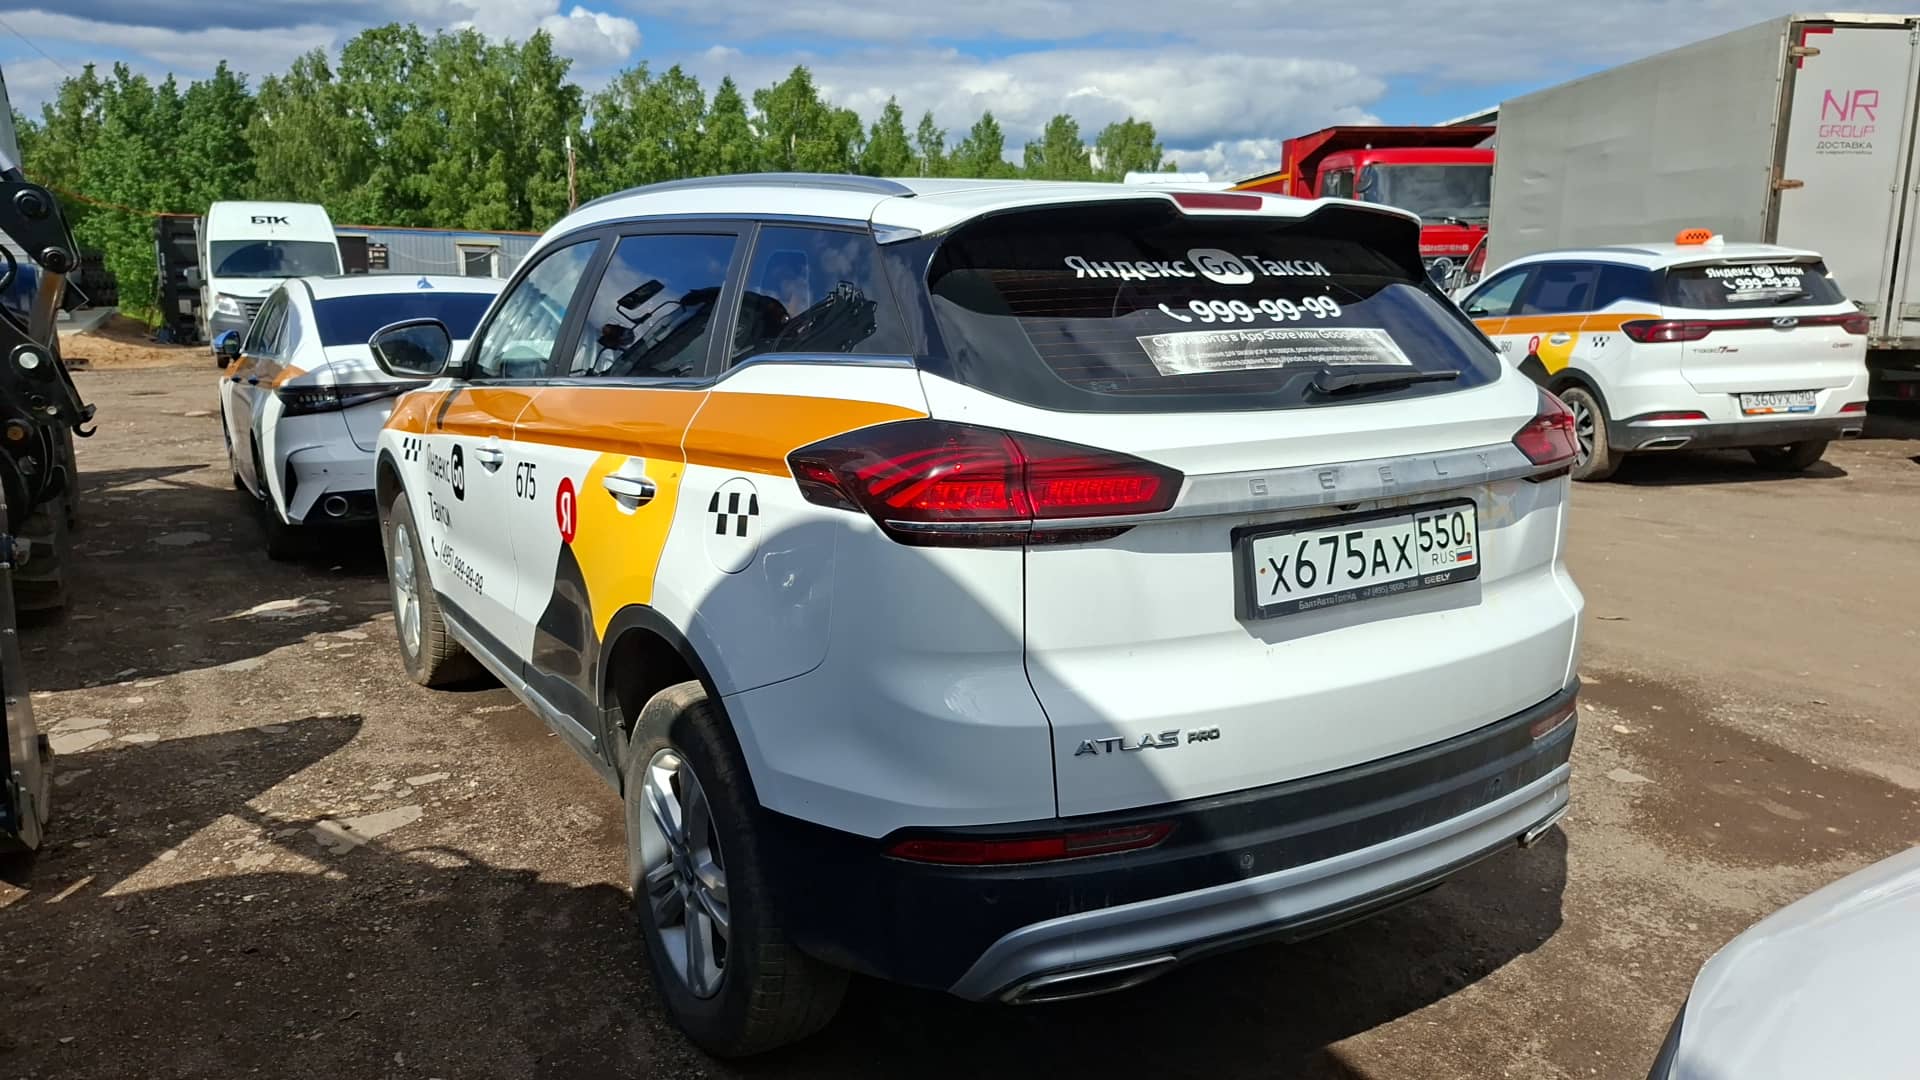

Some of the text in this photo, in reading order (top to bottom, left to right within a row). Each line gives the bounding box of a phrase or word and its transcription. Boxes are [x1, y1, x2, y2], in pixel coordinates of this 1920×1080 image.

[1821, 89, 1879, 122] NR
[1819, 124, 1875, 138] GROUP
[1815, 141, 1873, 150] ДОСТАВКА
[250, 215, 289, 225] БТК
[1064, 253, 1331, 281] Яндекс Go Такси
[1188, 295, 1342, 323] 999-99-99
[1240, 330, 1265, 343] App
[1264, 329, 1297, 341] Store
[516, 461, 537, 501] 675
[1249, 452, 1490, 497] GEELY
[561, 491, 572, 535] Я
[1417, 511, 1465, 552] 550
[1432, 551, 1456, 566] RUS
[1424, 572, 1451, 585] GEELY
[1074, 727, 1221, 757] ATLAS PRO
